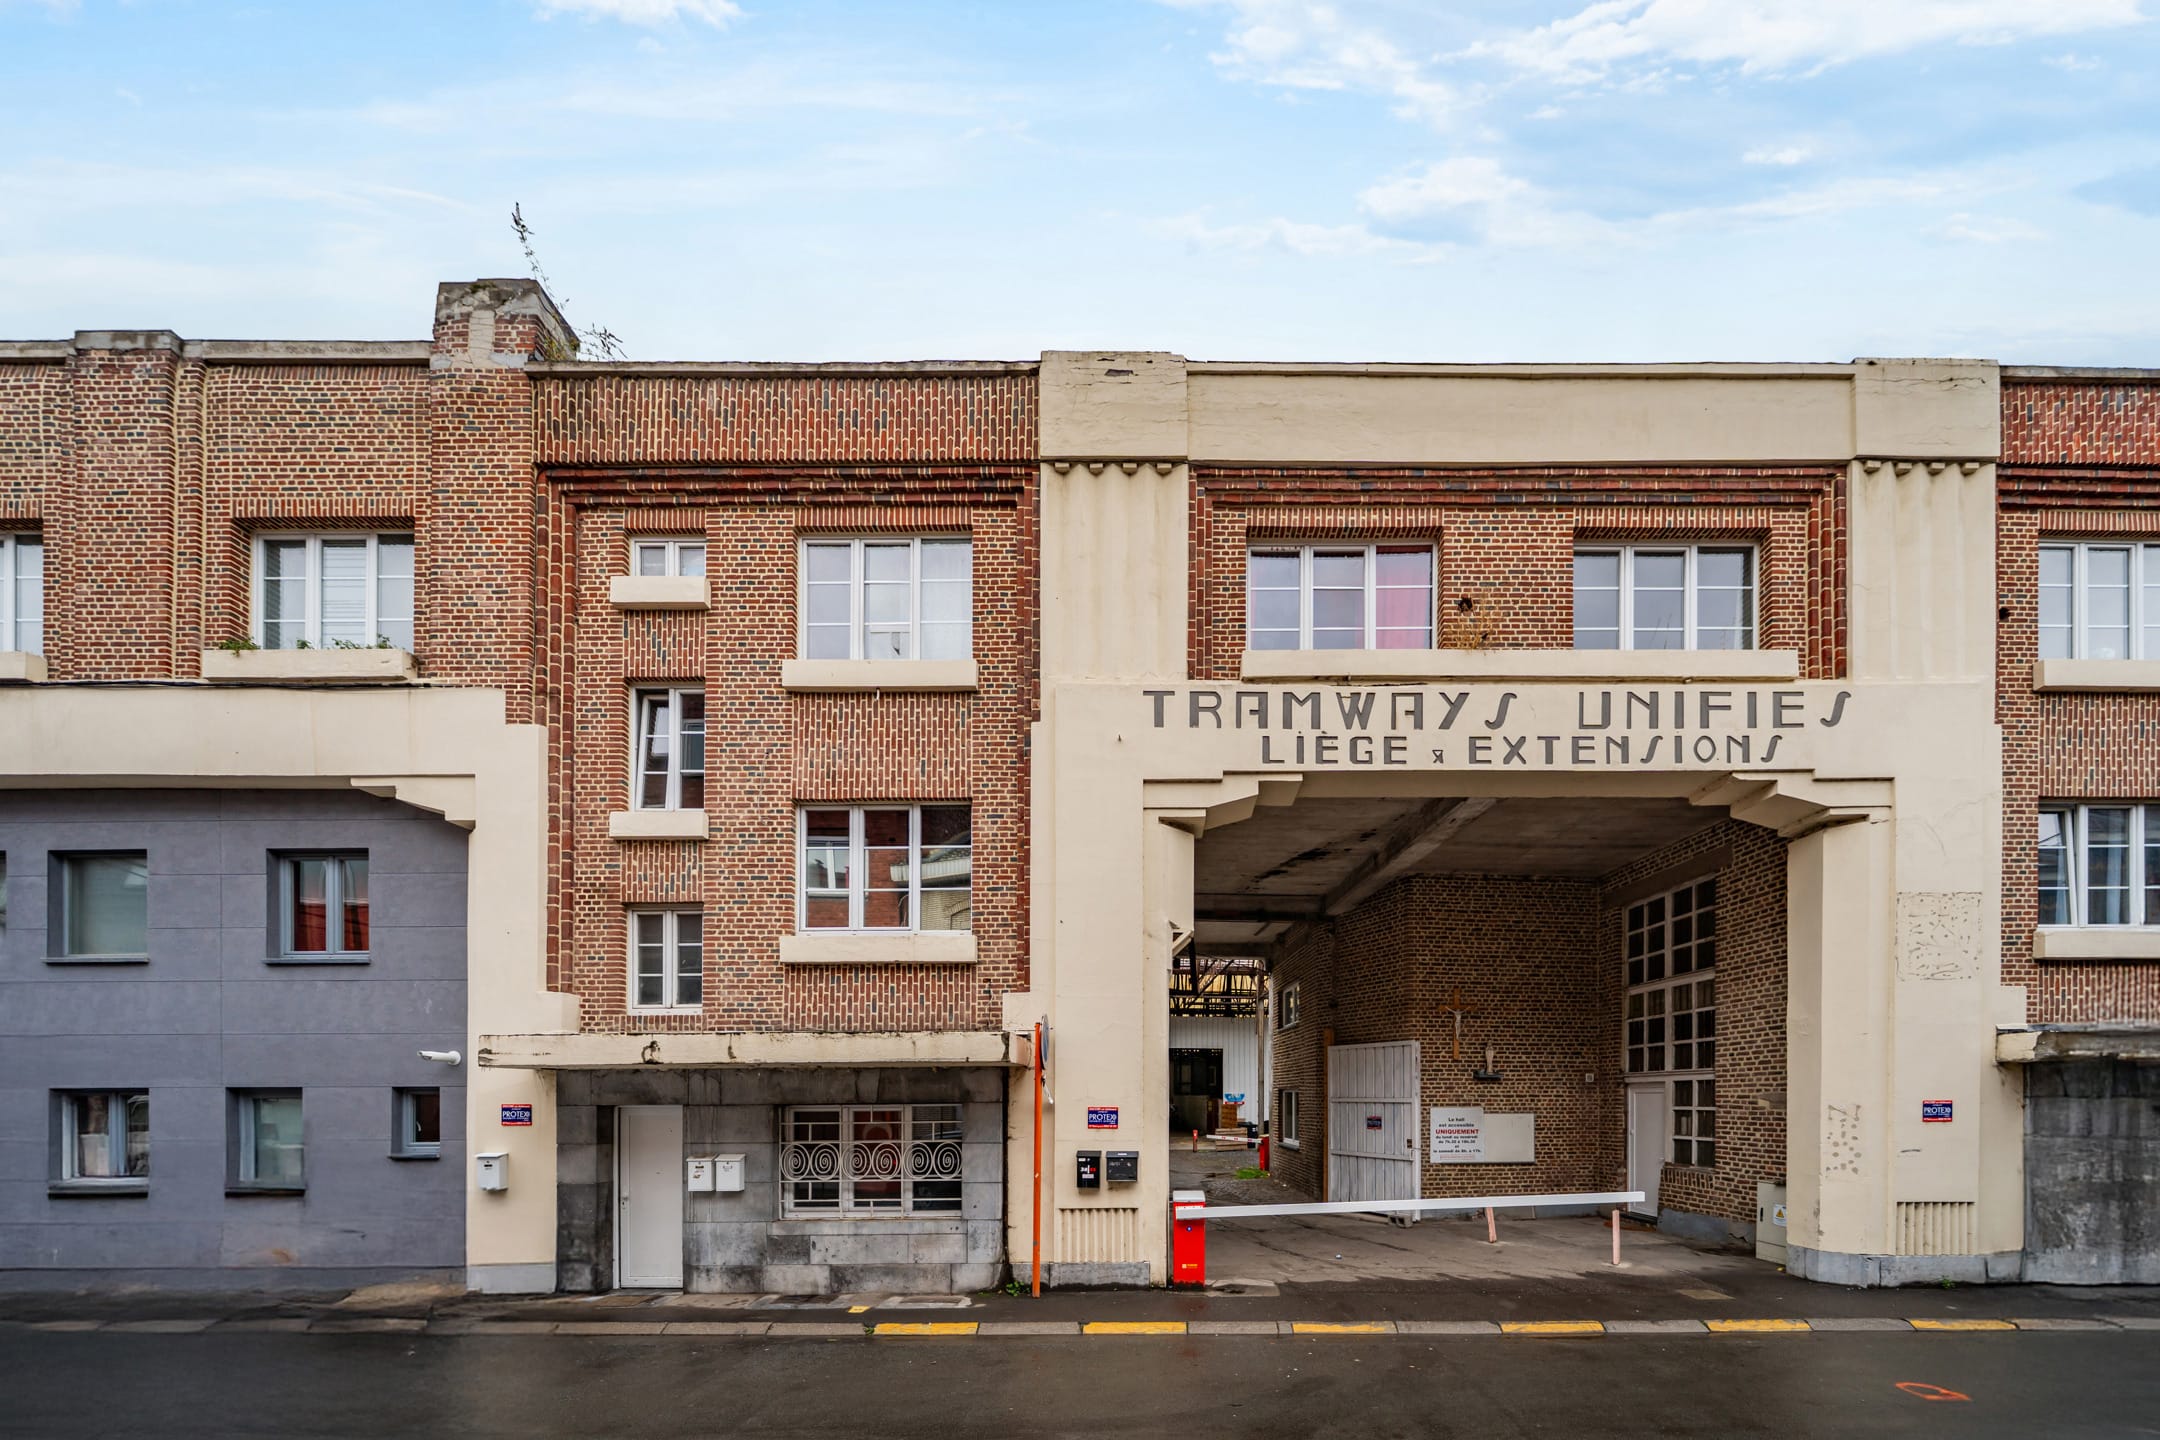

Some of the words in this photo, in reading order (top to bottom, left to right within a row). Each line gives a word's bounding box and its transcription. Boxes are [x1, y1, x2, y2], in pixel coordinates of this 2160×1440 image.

[1142, 690, 1518, 730] TRAMWAYS
[1578, 690, 1852, 730] UNIFIES
[1468, 735, 1784, 765] EXTENSIONS
